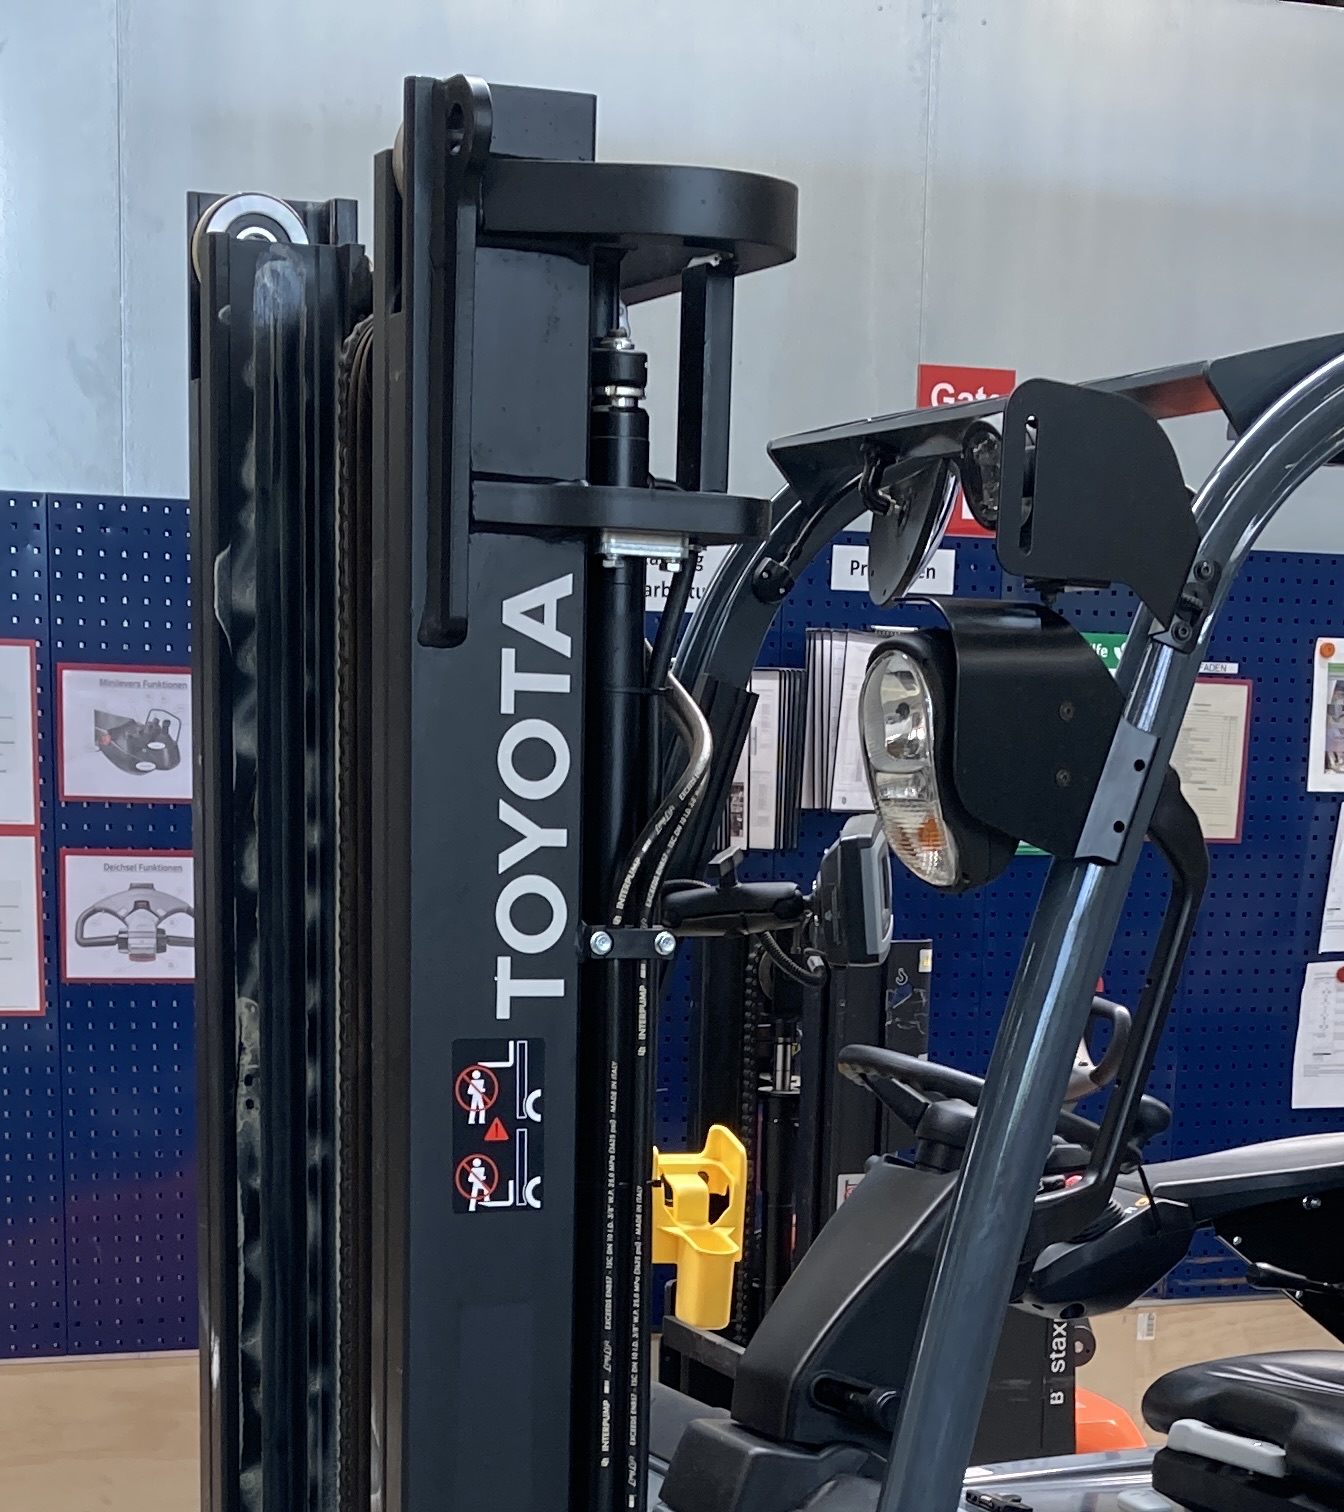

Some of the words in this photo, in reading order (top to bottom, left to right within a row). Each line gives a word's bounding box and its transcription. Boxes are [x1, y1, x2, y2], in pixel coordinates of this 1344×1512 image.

[495, 573, 574, 1020] TOYOTA
[638, 985, 647, 1040] INTERPUMP
[601, 1400, 610, 1452] INTERPUMP
